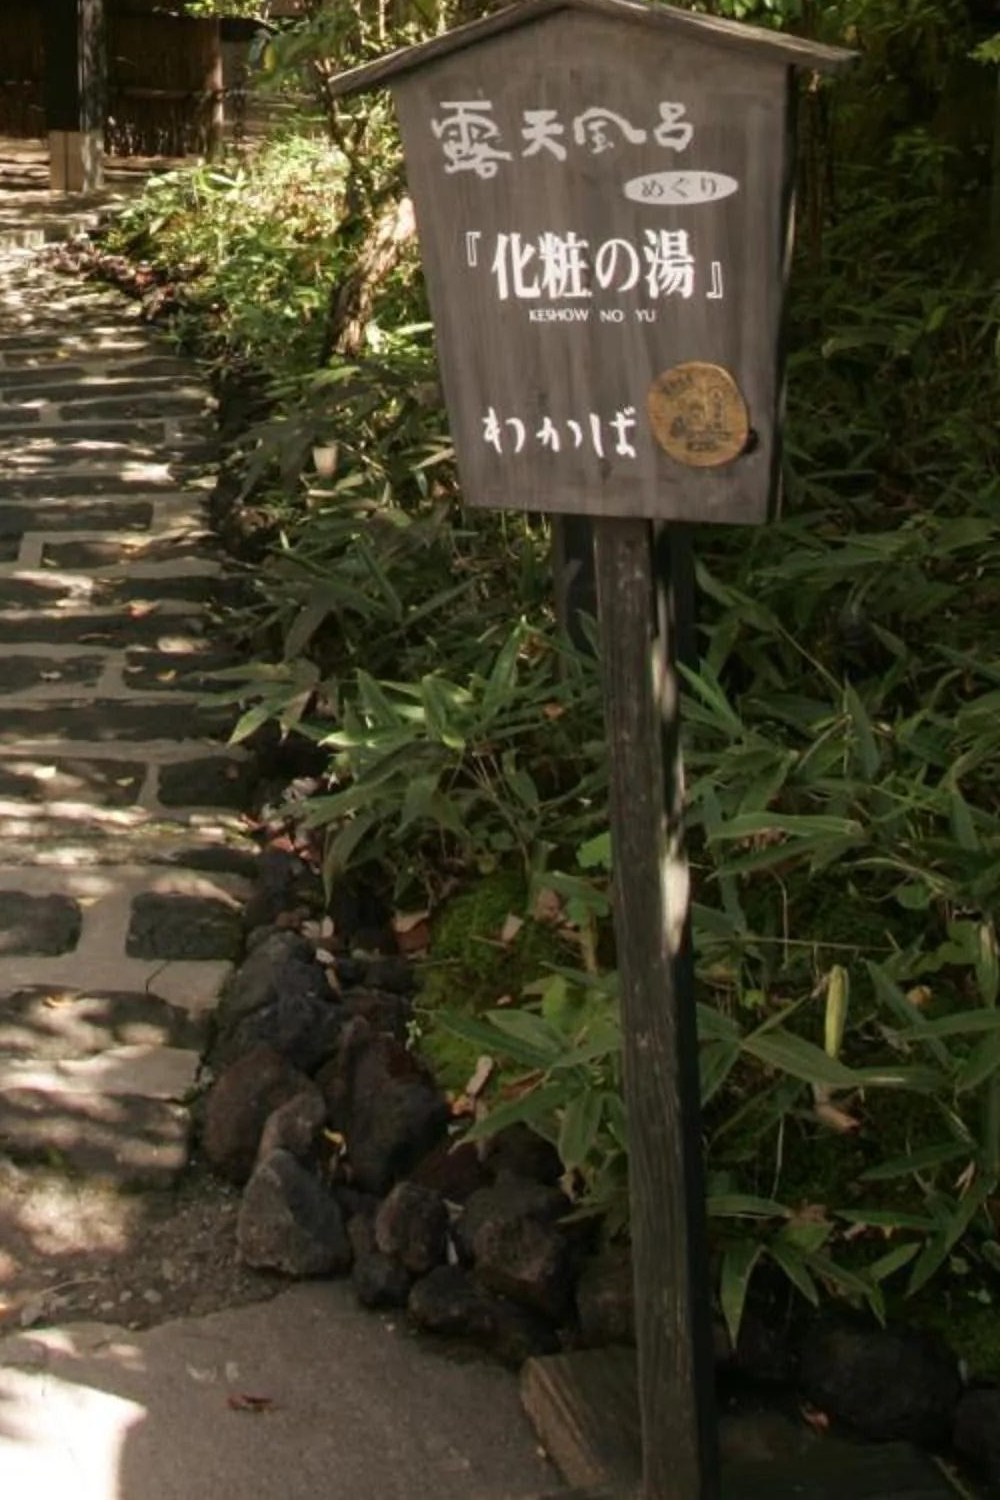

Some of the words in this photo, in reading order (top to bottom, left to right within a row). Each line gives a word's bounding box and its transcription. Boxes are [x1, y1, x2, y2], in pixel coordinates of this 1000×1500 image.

[431, 100, 694, 179] 露天風呂
[641, 178, 718, 198] めぐり
[464, 228, 724, 300] 『化粧の湯』
[529, 308, 589, 322] KESHOW
[600, 310, 625, 323] NO
[636, 309, 656, 323] YU
[481, 406, 638, 459] わかば
